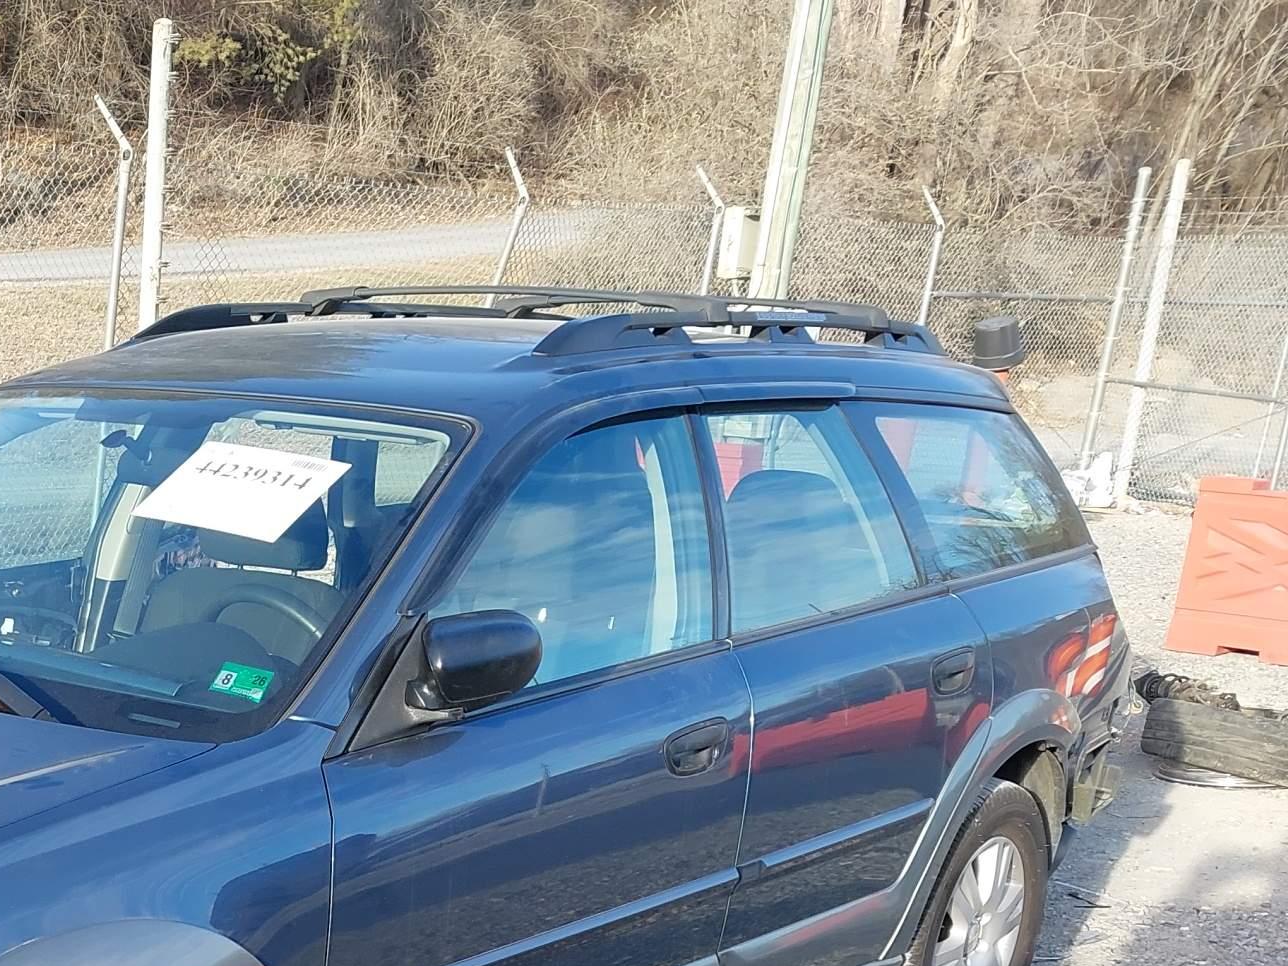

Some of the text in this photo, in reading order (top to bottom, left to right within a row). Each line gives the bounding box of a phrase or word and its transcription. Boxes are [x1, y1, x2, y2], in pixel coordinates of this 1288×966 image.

[195, 461, 312, 490] 44239314
[222, 673, 268, 687] 8 26
